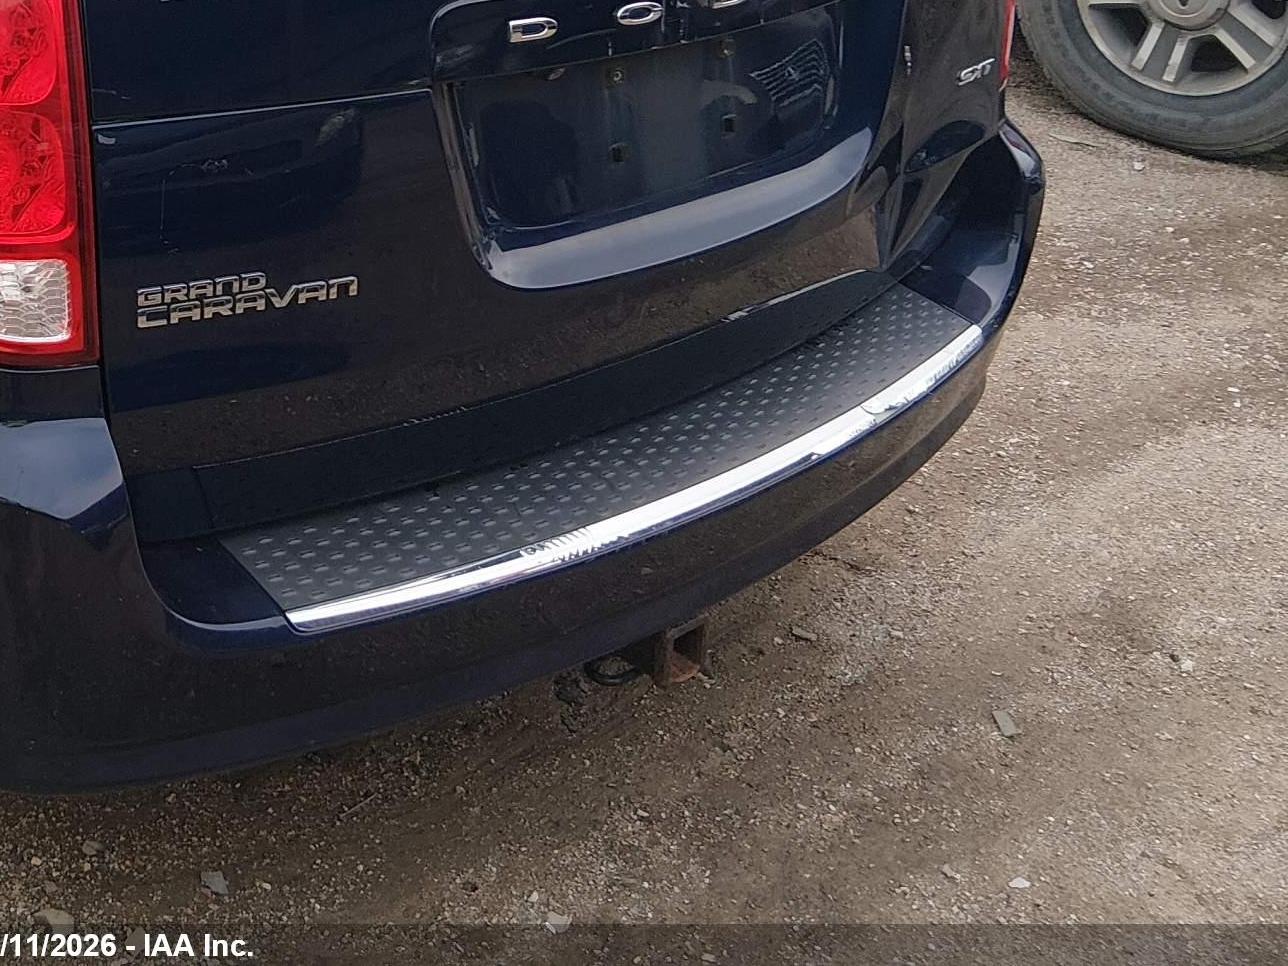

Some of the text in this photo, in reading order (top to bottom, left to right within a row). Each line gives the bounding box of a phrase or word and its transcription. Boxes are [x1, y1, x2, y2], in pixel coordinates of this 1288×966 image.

[957, 58, 996, 86] SXT
[137, 272, 266, 307] GRAND
[137, 276, 359, 328] CARAVAN
